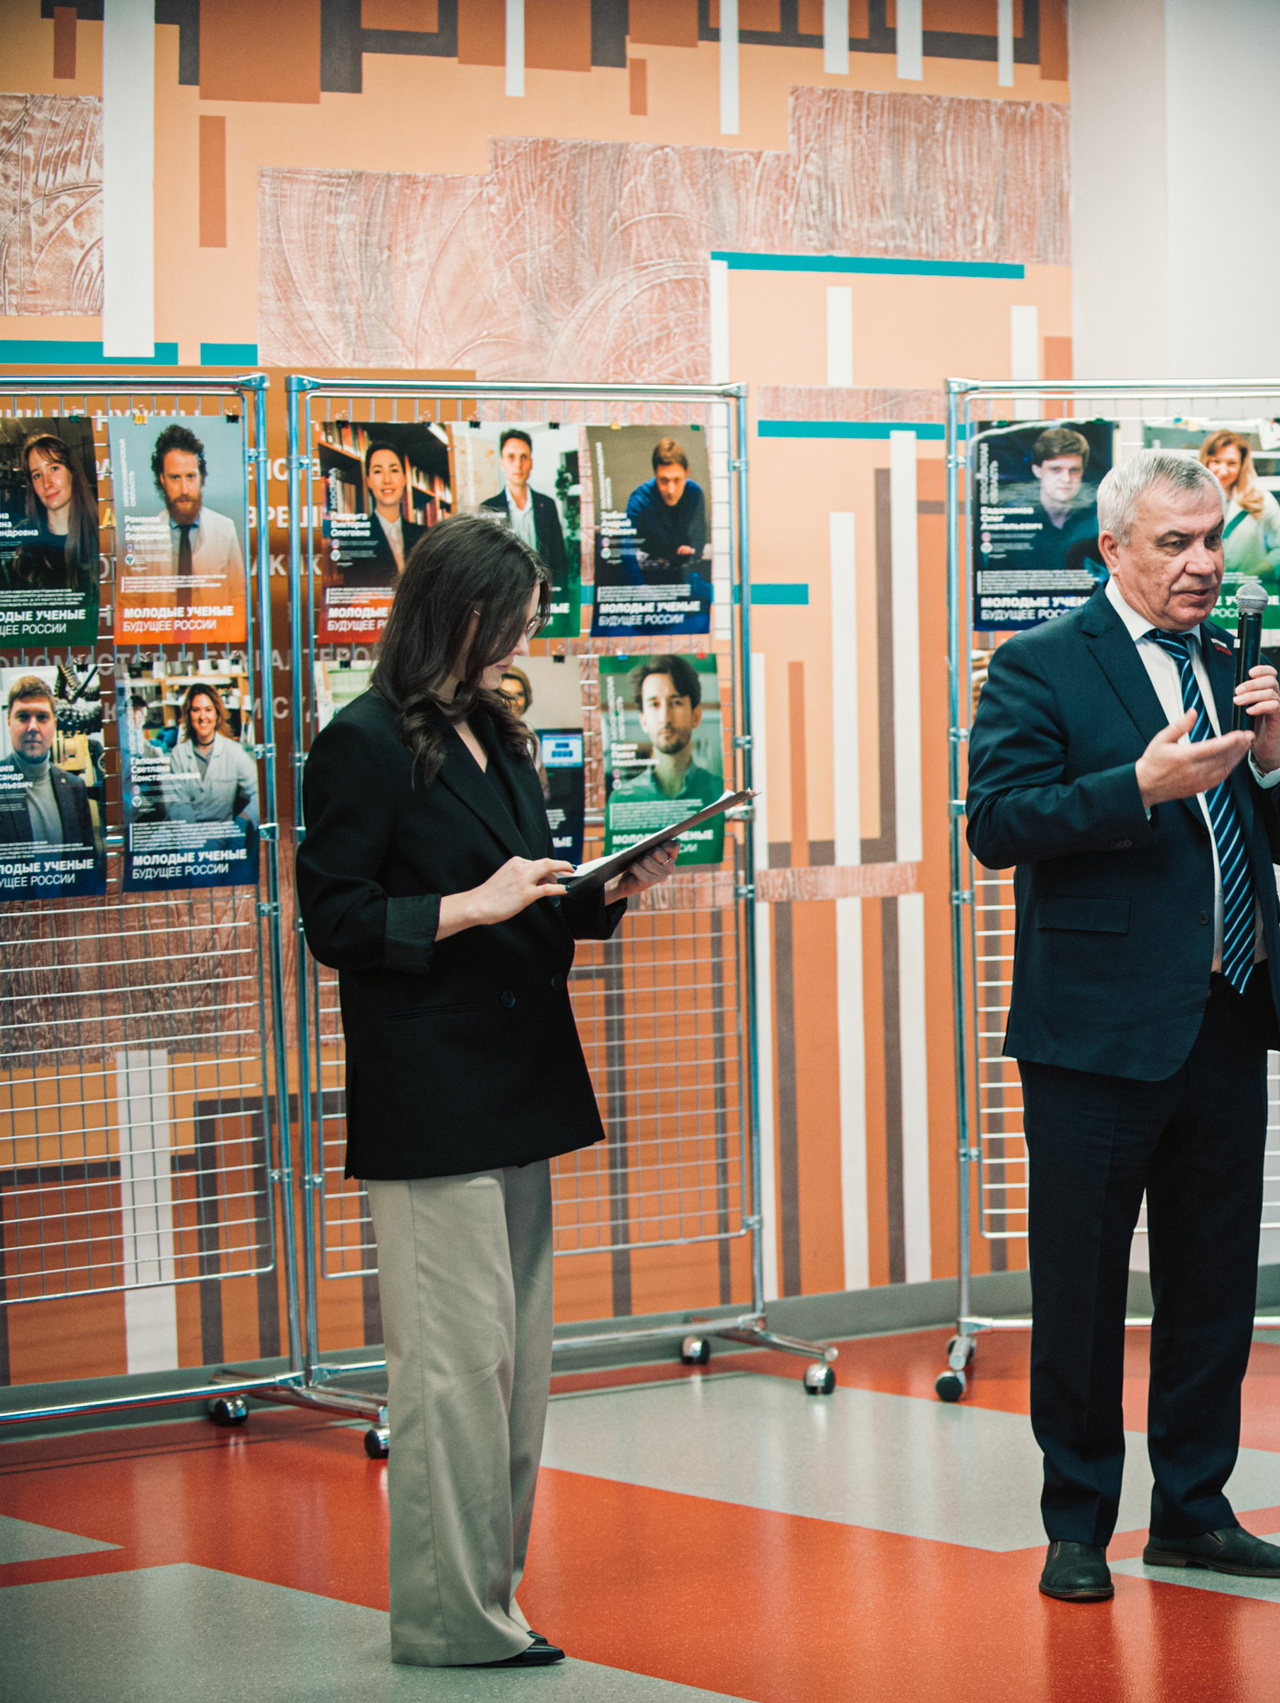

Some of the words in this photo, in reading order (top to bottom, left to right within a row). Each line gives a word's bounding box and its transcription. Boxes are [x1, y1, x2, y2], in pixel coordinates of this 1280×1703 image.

[328, 467, 337, 509] МОСКВА
[989, 460, 998, 505] ОБЛАСТЬ
[980, 515, 1005, 523] Олег
[980, 523, 1043, 531] Анатольевич
[599, 602, 655, 614] МОЛОДЫЕ
[657, 601, 701, 612] УЧЕНЫЕ
[981, 597, 1050, 609] МОЛОДЫЕ
[1052, 596, 1091, 608] УЧЕН
[36, 609, 86, 620] УЧЕНЫЕ
[123, 607, 185, 619] МОЛОДЫЕ
[187, 605, 234, 617] УЧЕНЫЕ
[328, 607, 389, 619] МОЛОДЫЕ
[981, 609, 1036, 621] БУДУЩЕЕ
[123, 620, 172, 633] БУДУЩЕЕ
[174, 619, 217, 630] РОССИИ
[327, 620, 375, 632] БУДУЩЕЕ
[598, 614, 643, 627] БУДУЩЕЕ
[644, 613, 684, 625] РОССИИ
[22, 623, 67, 634] РОССИИ
[131, 765, 170, 774] Светлана
[131, 772, 201, 782] Константиновна
[132, 852, 195, 866] МОЛОДЫЕ
[198, 848, 247, 862] УЧЕНЫЕ
[44, 859, 94, 872] УЧЕНЫЕ
[132, 866, 182, 880] БУДУЩЕЕ
[184, 863, 229, 876] РОССИИ
[30, 873, 75, 886] РОССИИ
